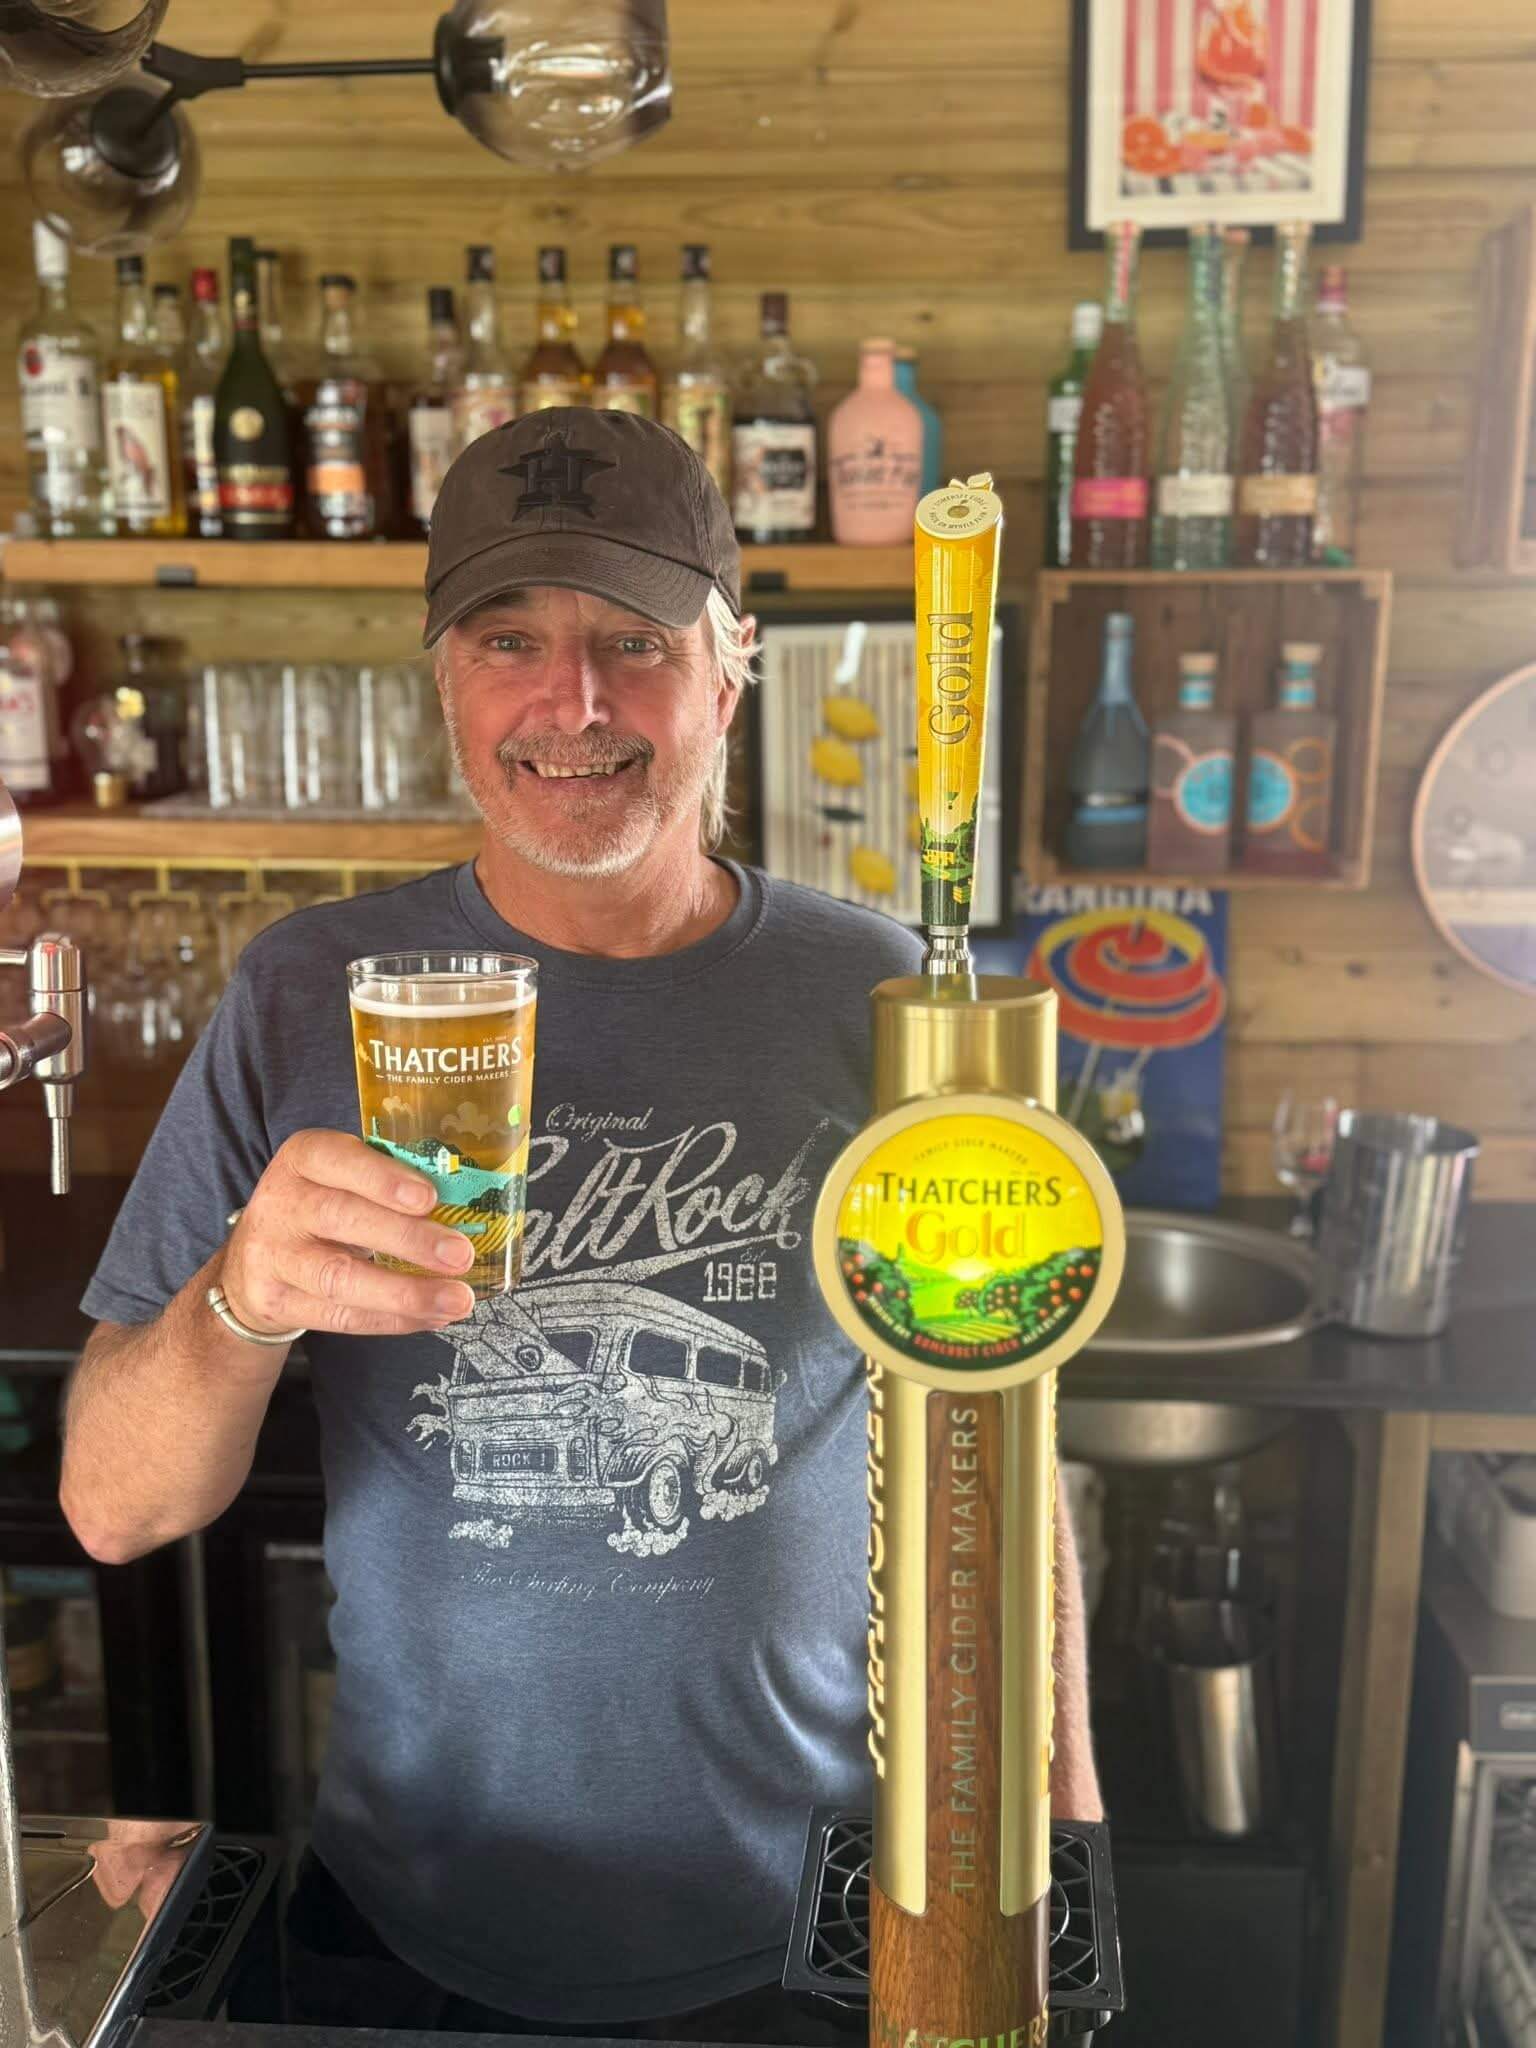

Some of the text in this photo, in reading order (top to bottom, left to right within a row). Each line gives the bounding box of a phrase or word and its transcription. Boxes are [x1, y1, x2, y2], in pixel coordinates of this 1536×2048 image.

[926, 612, 974, 744] Gold
[369, 1037, 522, 1073] THATCHERS
[387, 1070, 510, 1085] THE FAMILY CIDER MAKERS
[545, 1102, 655, 1143] Original
[877, 1171, 1062, 1208] THATCHERS
[905, 1209, 1029, 1265] Gold
[492, 1451, 531, 1467] ROCK
[951, 1407, 979, 1894] THE FAMILY CIDER MAKERS
